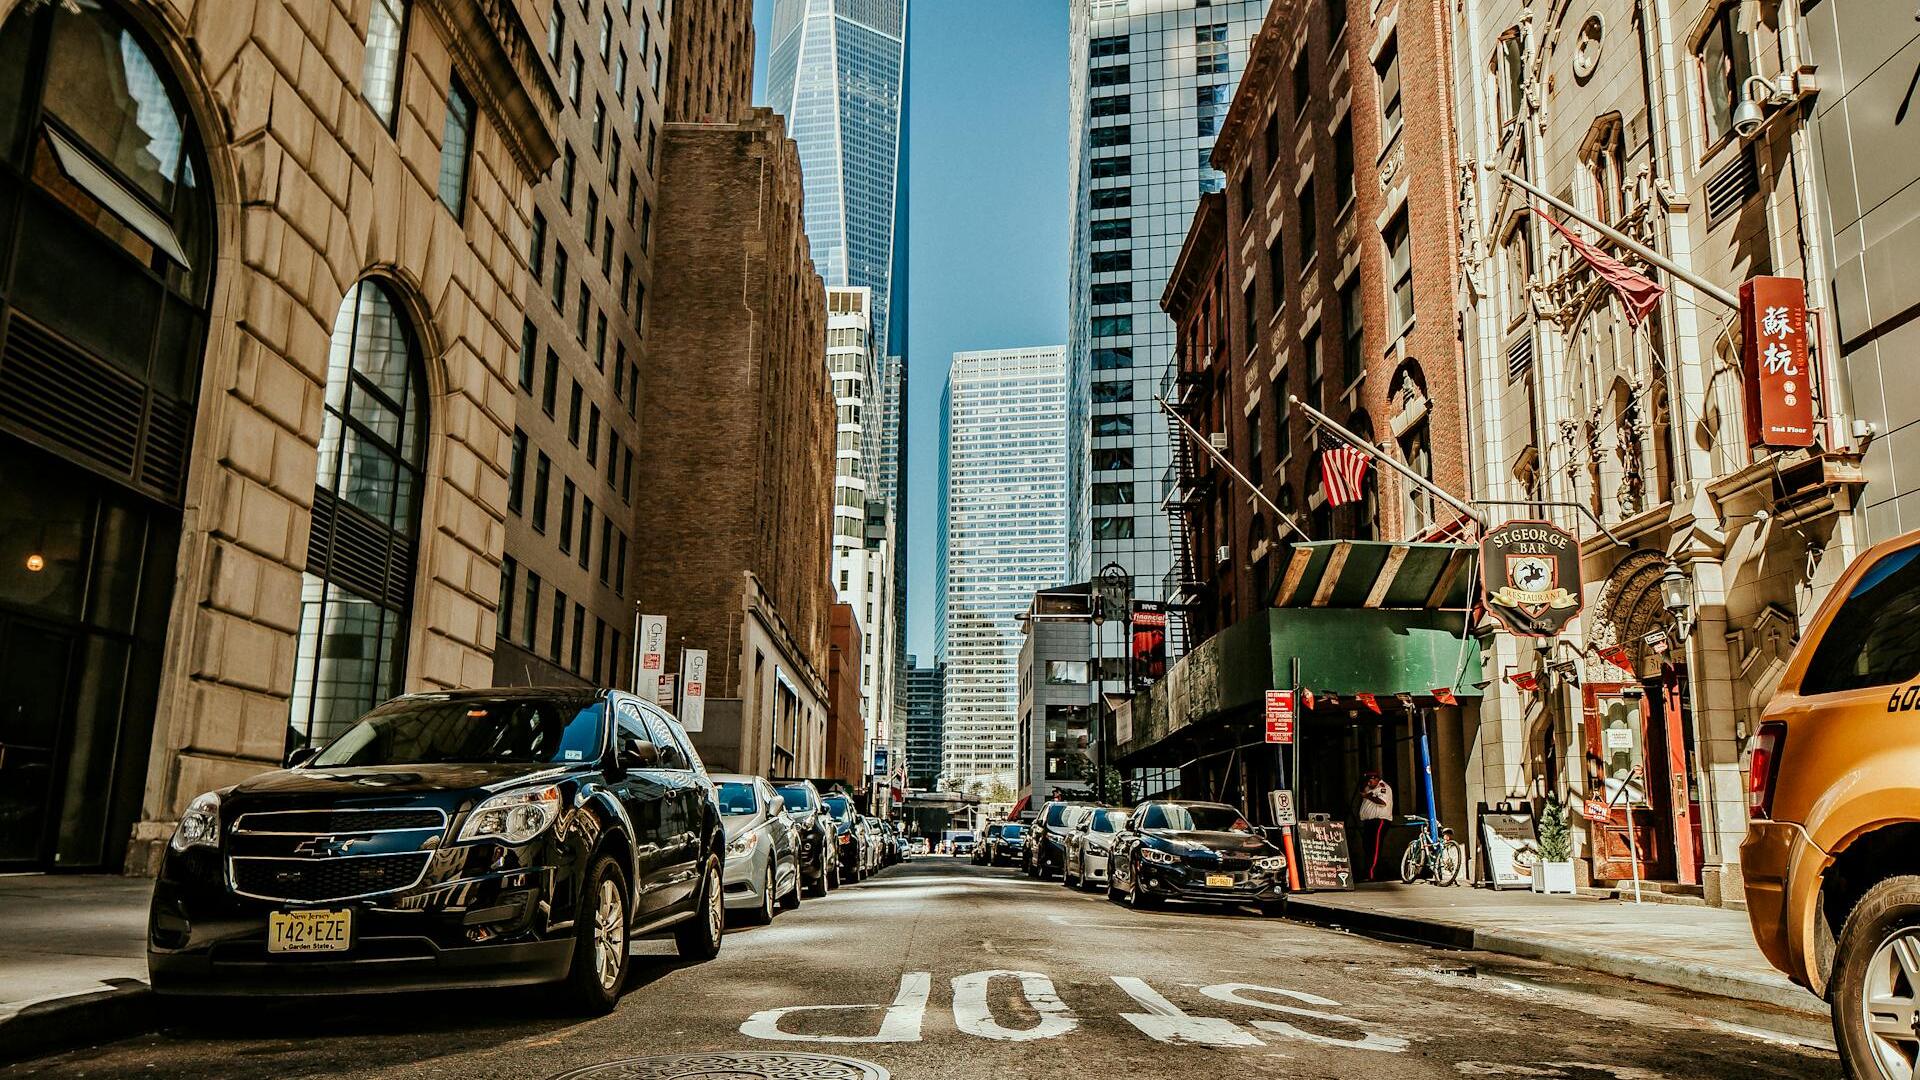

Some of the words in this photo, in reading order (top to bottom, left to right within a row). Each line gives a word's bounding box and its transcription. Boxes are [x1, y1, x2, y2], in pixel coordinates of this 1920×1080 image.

[1761, 305, 1799, 376] 蘇杭
[1787, 426, 1807, 434] Floor
[1520, 542, 1548, 554] BAR
[1506, 590, 1561, 601] RESTAURANT
[1141, 603, 1158, 611] NYC
[1133, 612, 1165, 621] financial
[651, 622, 663, 652] China
[693, 656, 704, 680] China
[1887, 686, 1920, 712] 60
[308, 913, 330, 921] Jersey
[276, 922, 304, 942] T42
[315, 921, 344, 941] EZE
[288, 943, 311, 951] Garden
[739, 969, 1410, 1053] STOP
